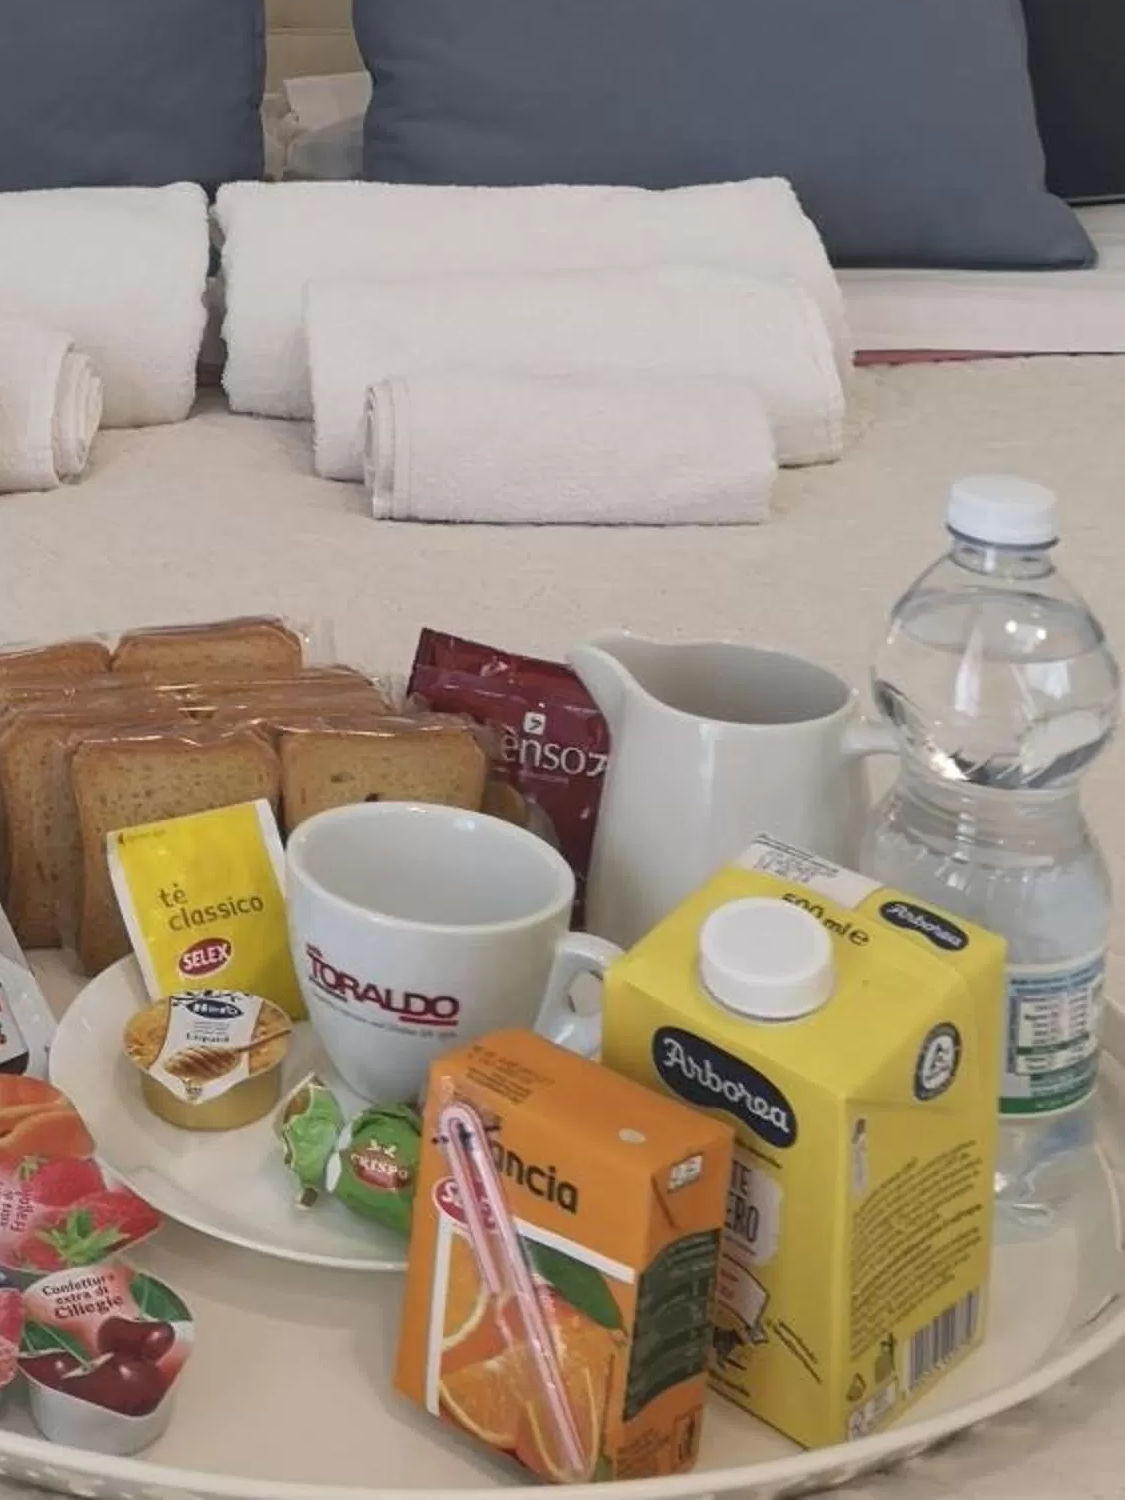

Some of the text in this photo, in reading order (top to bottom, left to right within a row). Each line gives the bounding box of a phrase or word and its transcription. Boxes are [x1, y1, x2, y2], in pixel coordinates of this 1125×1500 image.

[168, 896, 264, 931] classico
[183, 943, 228, 971] SELEX
[306, 950, 460, 1018] TORALDO
[663, 1037, 789, 1133] Arborea
[42, 1273, 116, 1296] Confettura
[54, 1295, 124, 1319] Ciliegie
